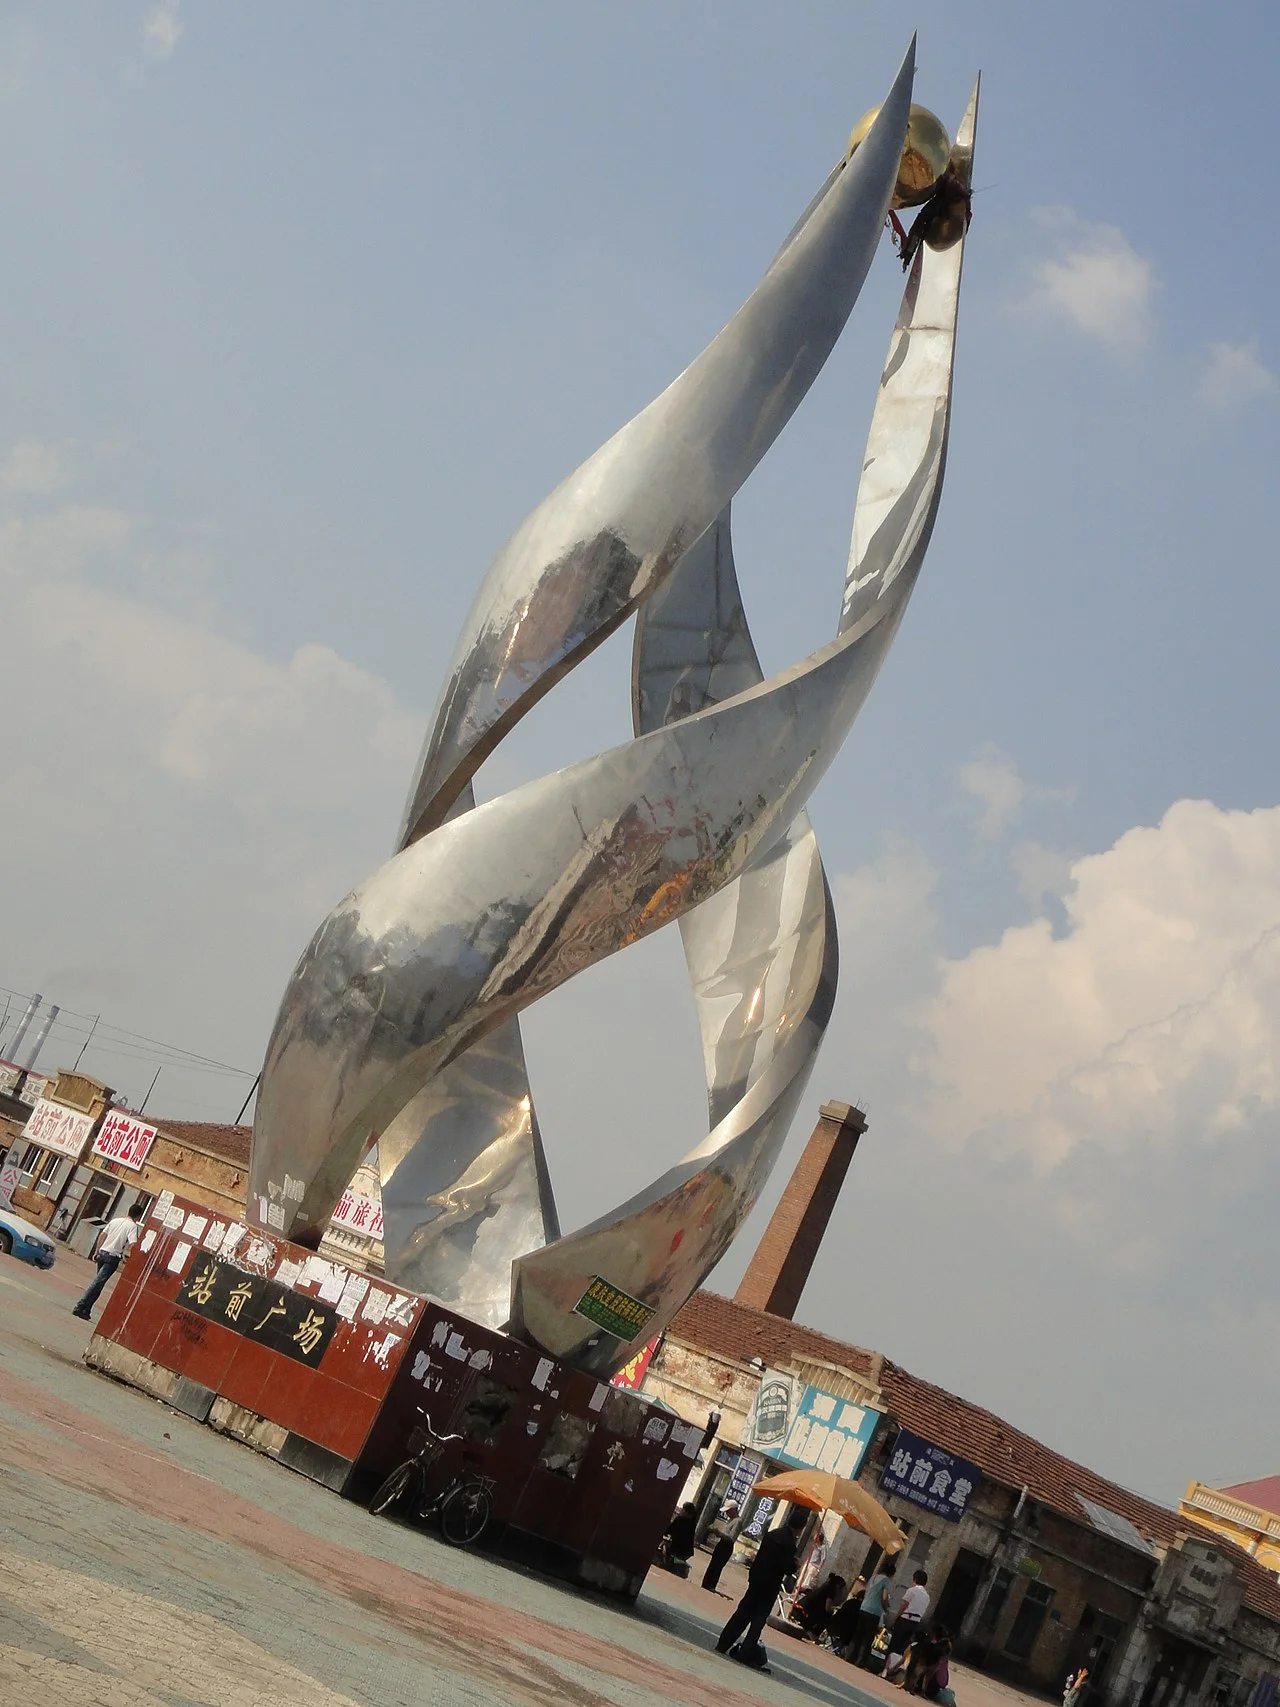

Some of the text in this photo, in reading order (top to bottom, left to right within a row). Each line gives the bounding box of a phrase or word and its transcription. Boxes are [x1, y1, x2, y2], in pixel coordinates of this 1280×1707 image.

[28, 1103, 89, 1151] 站前公厕
[97, 1115, 155, 1166] 站前公厕
[188, 1264, 326, 1355] 站前广场
[889, 1448, 973, 1507] 站前食堂
